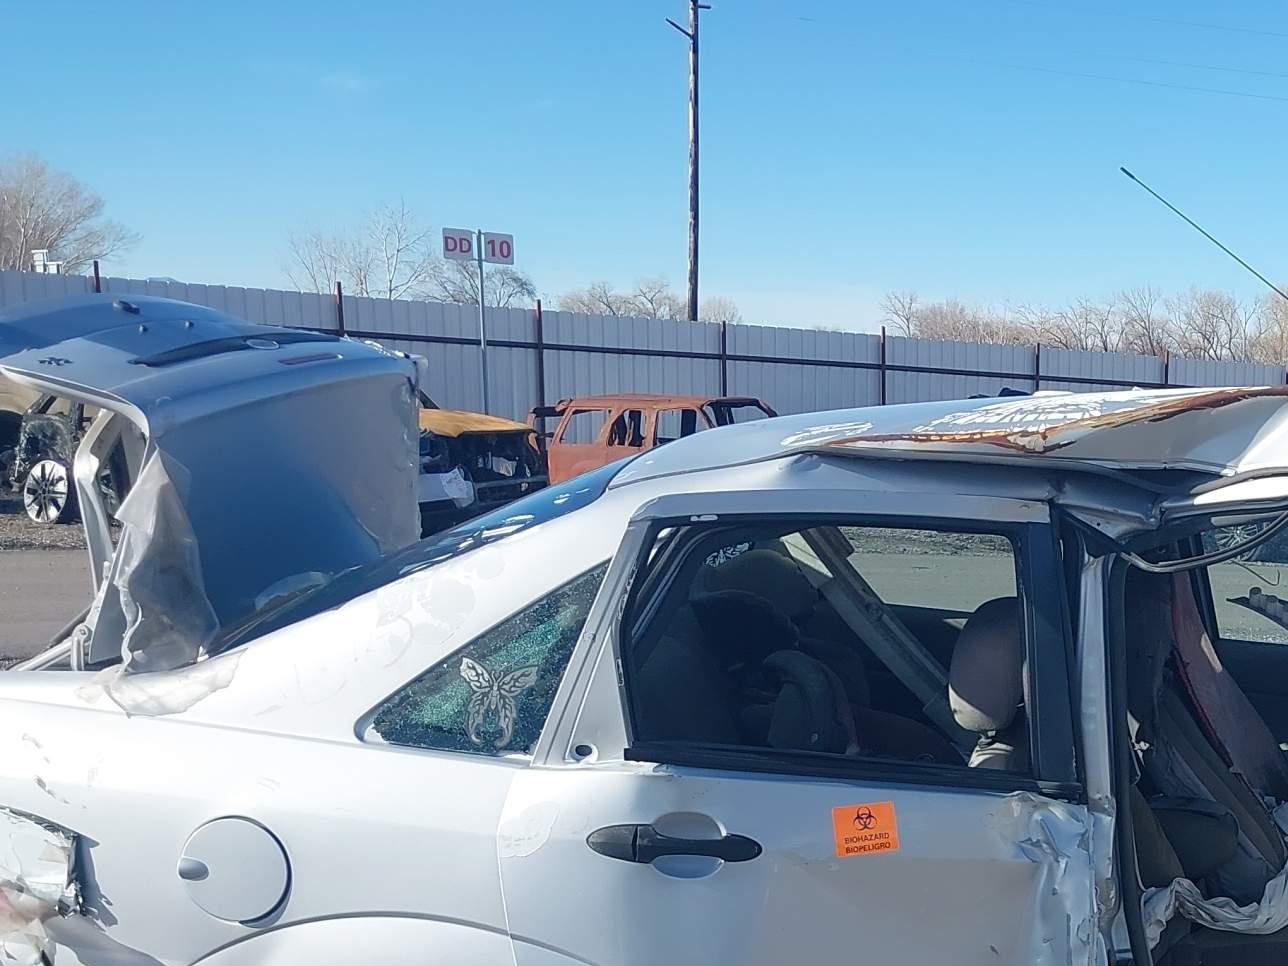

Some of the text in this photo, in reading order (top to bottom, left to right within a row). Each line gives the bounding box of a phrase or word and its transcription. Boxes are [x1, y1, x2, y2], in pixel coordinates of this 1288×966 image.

[444, 236, 511, 258] DD 10
[844, 832, 890, 845] BIOHAZARD
[845, 841, 891, 854] BIOPELIGRO
